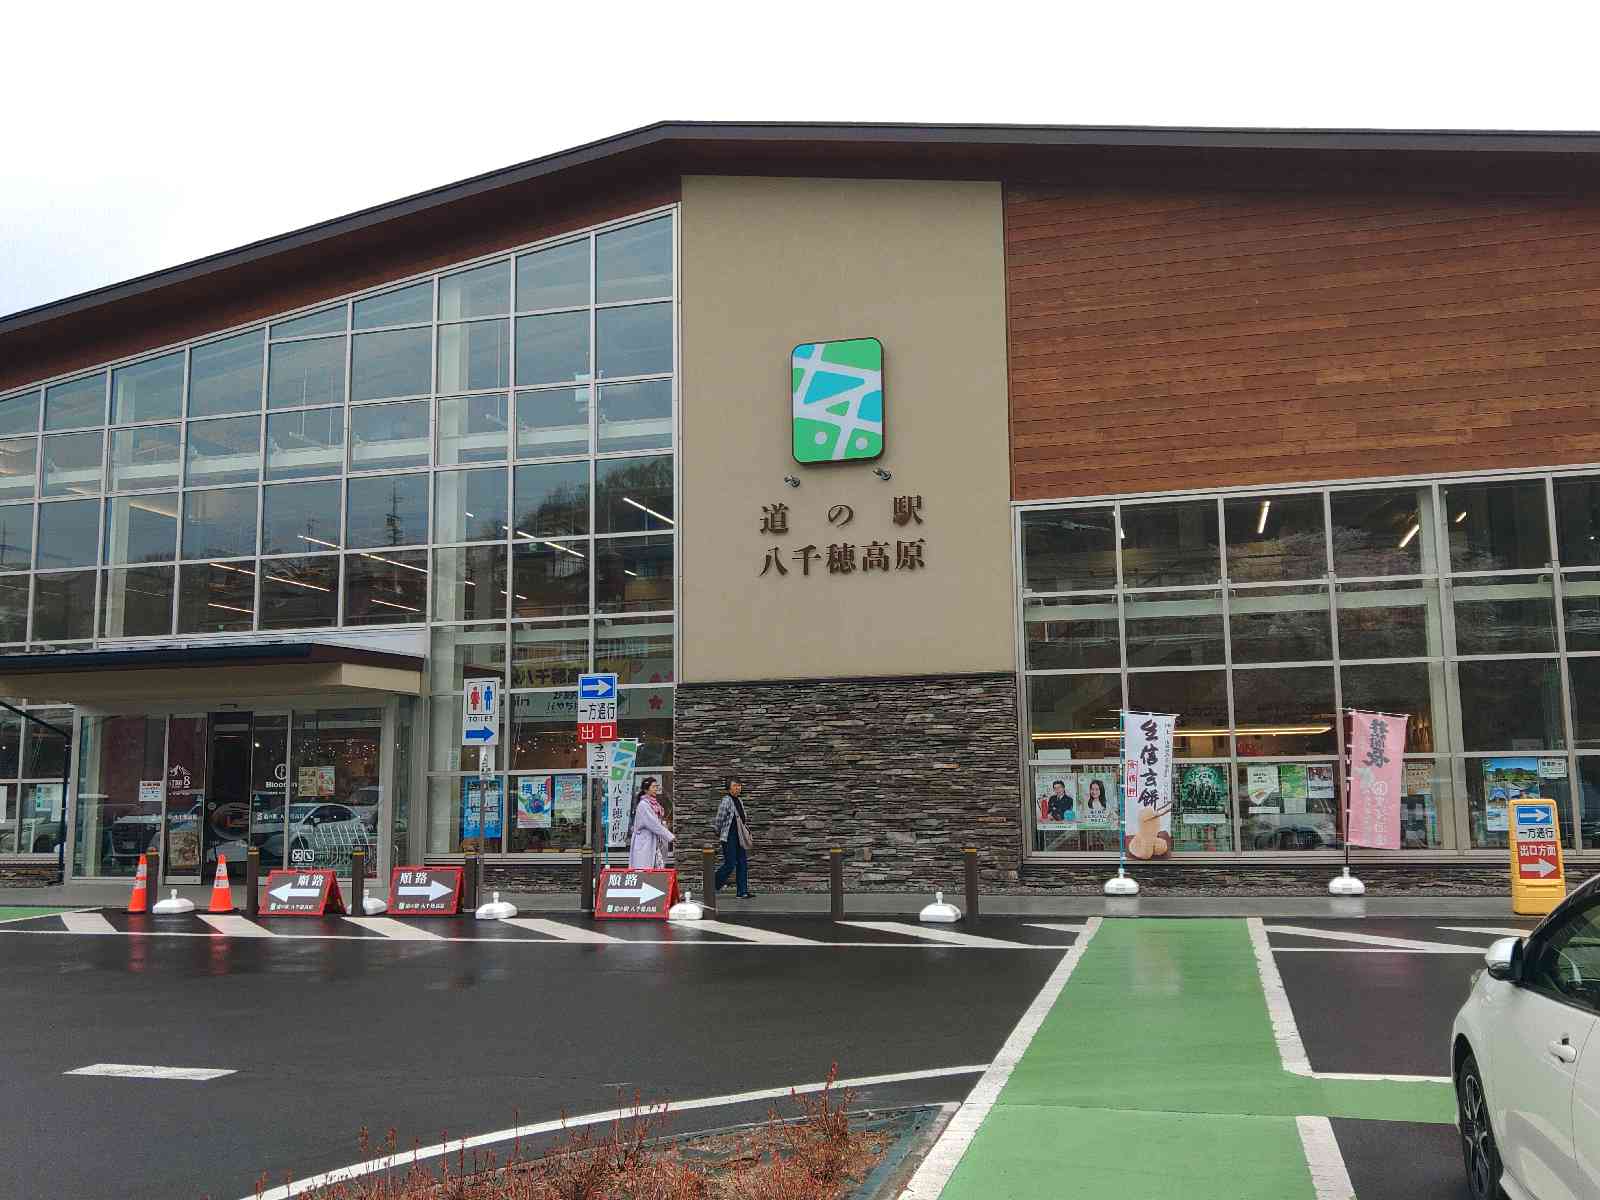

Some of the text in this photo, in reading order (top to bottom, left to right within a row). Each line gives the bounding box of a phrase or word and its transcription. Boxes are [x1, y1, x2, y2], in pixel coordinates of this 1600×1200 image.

[760, 494, 923, 535] 道の駅
[759, 537, 926, 576] 八千穂高原
[579, 702, 616, 720] 一方通行
[468, 715, 493, 723] TOILET
[581, 724, 613, 740] 出口
[1137, 719, 1160, 811] 生信玄餅
[1518, 827, 1555, 839] 一方通行
[1520, 844, 1556, 857] 出口方面
[297, 874, 324, 887] 順路
[399, 872, 428, 884] 順路
[608, 873, 639, 887] 順路
